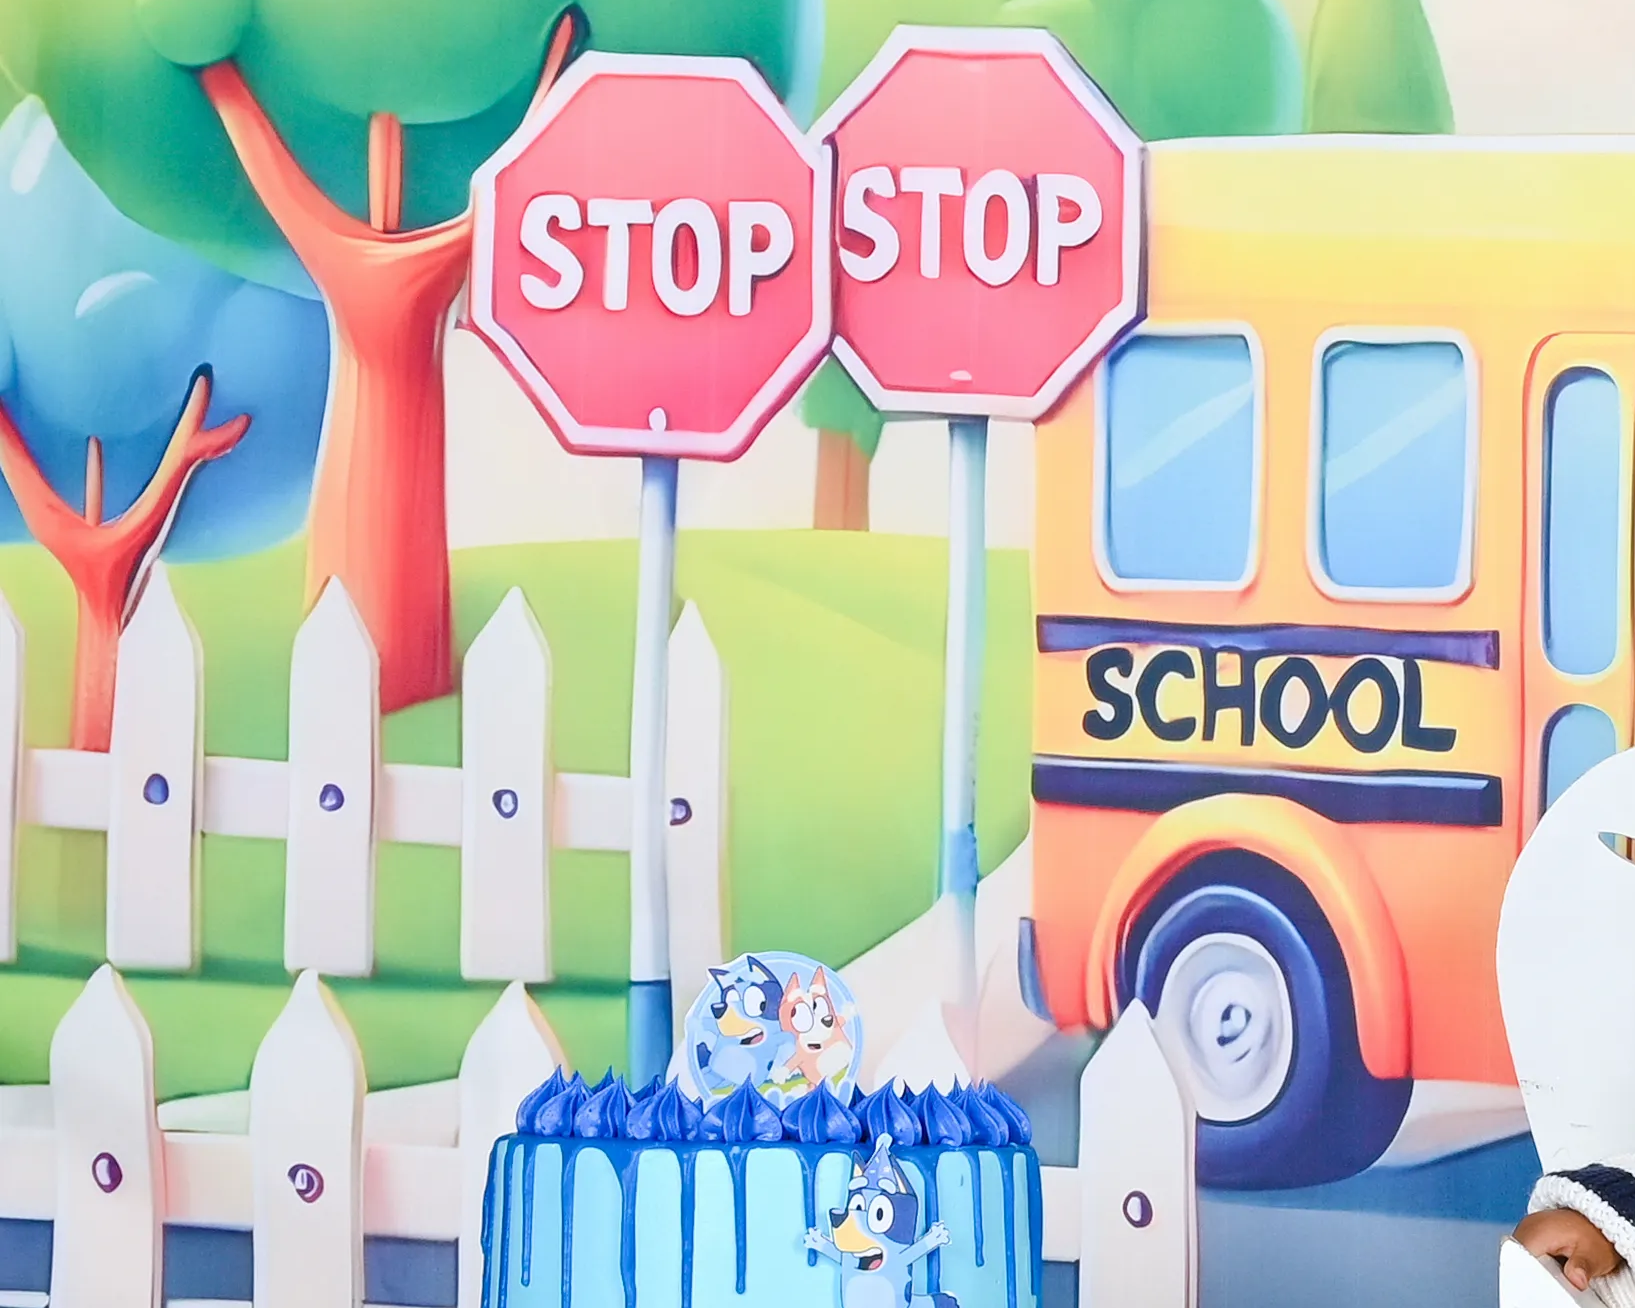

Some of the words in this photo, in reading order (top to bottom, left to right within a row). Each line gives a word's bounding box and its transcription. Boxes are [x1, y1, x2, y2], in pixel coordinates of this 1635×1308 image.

[519, 194, 794, 318] STOP
[839, 165, 1103, 286] STOP
[1083, 646, 1457, 753] SCHOOL
